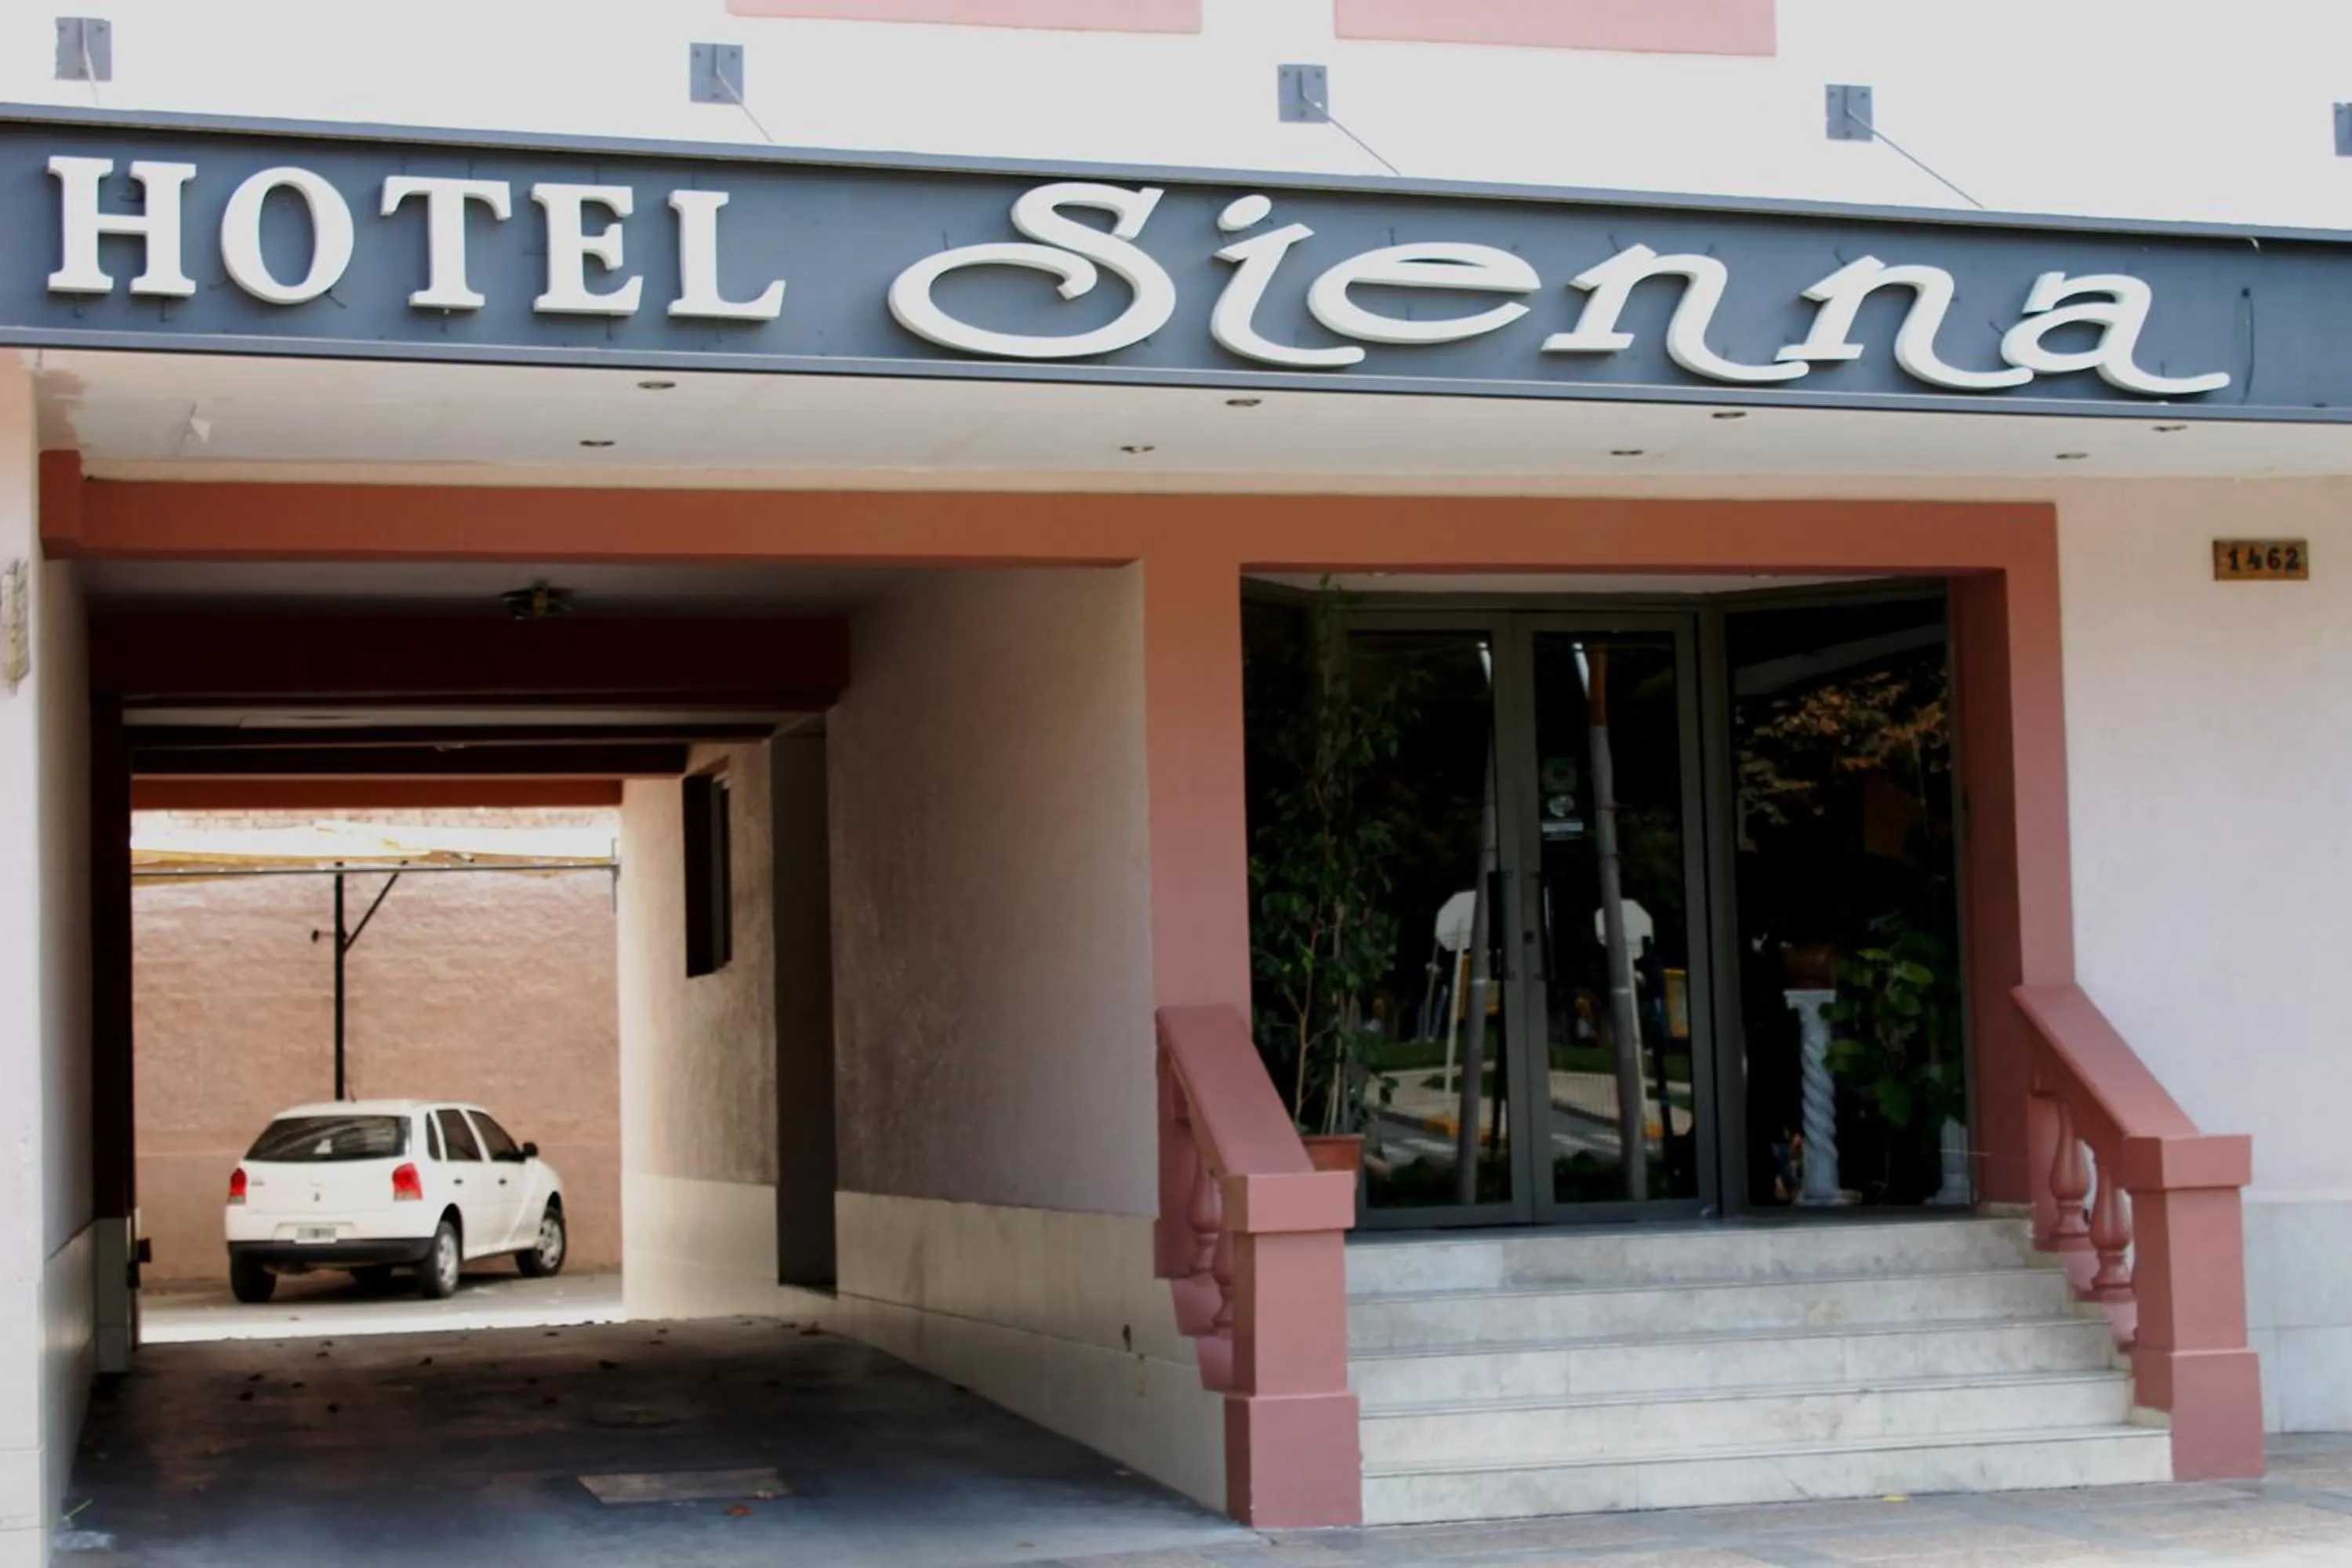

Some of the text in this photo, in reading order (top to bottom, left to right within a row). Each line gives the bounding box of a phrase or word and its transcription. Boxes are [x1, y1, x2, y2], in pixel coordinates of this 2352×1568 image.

[47, 155, 2231, 394] HOTEL Sienna
[2227, 546, 2300, 572] 1462
